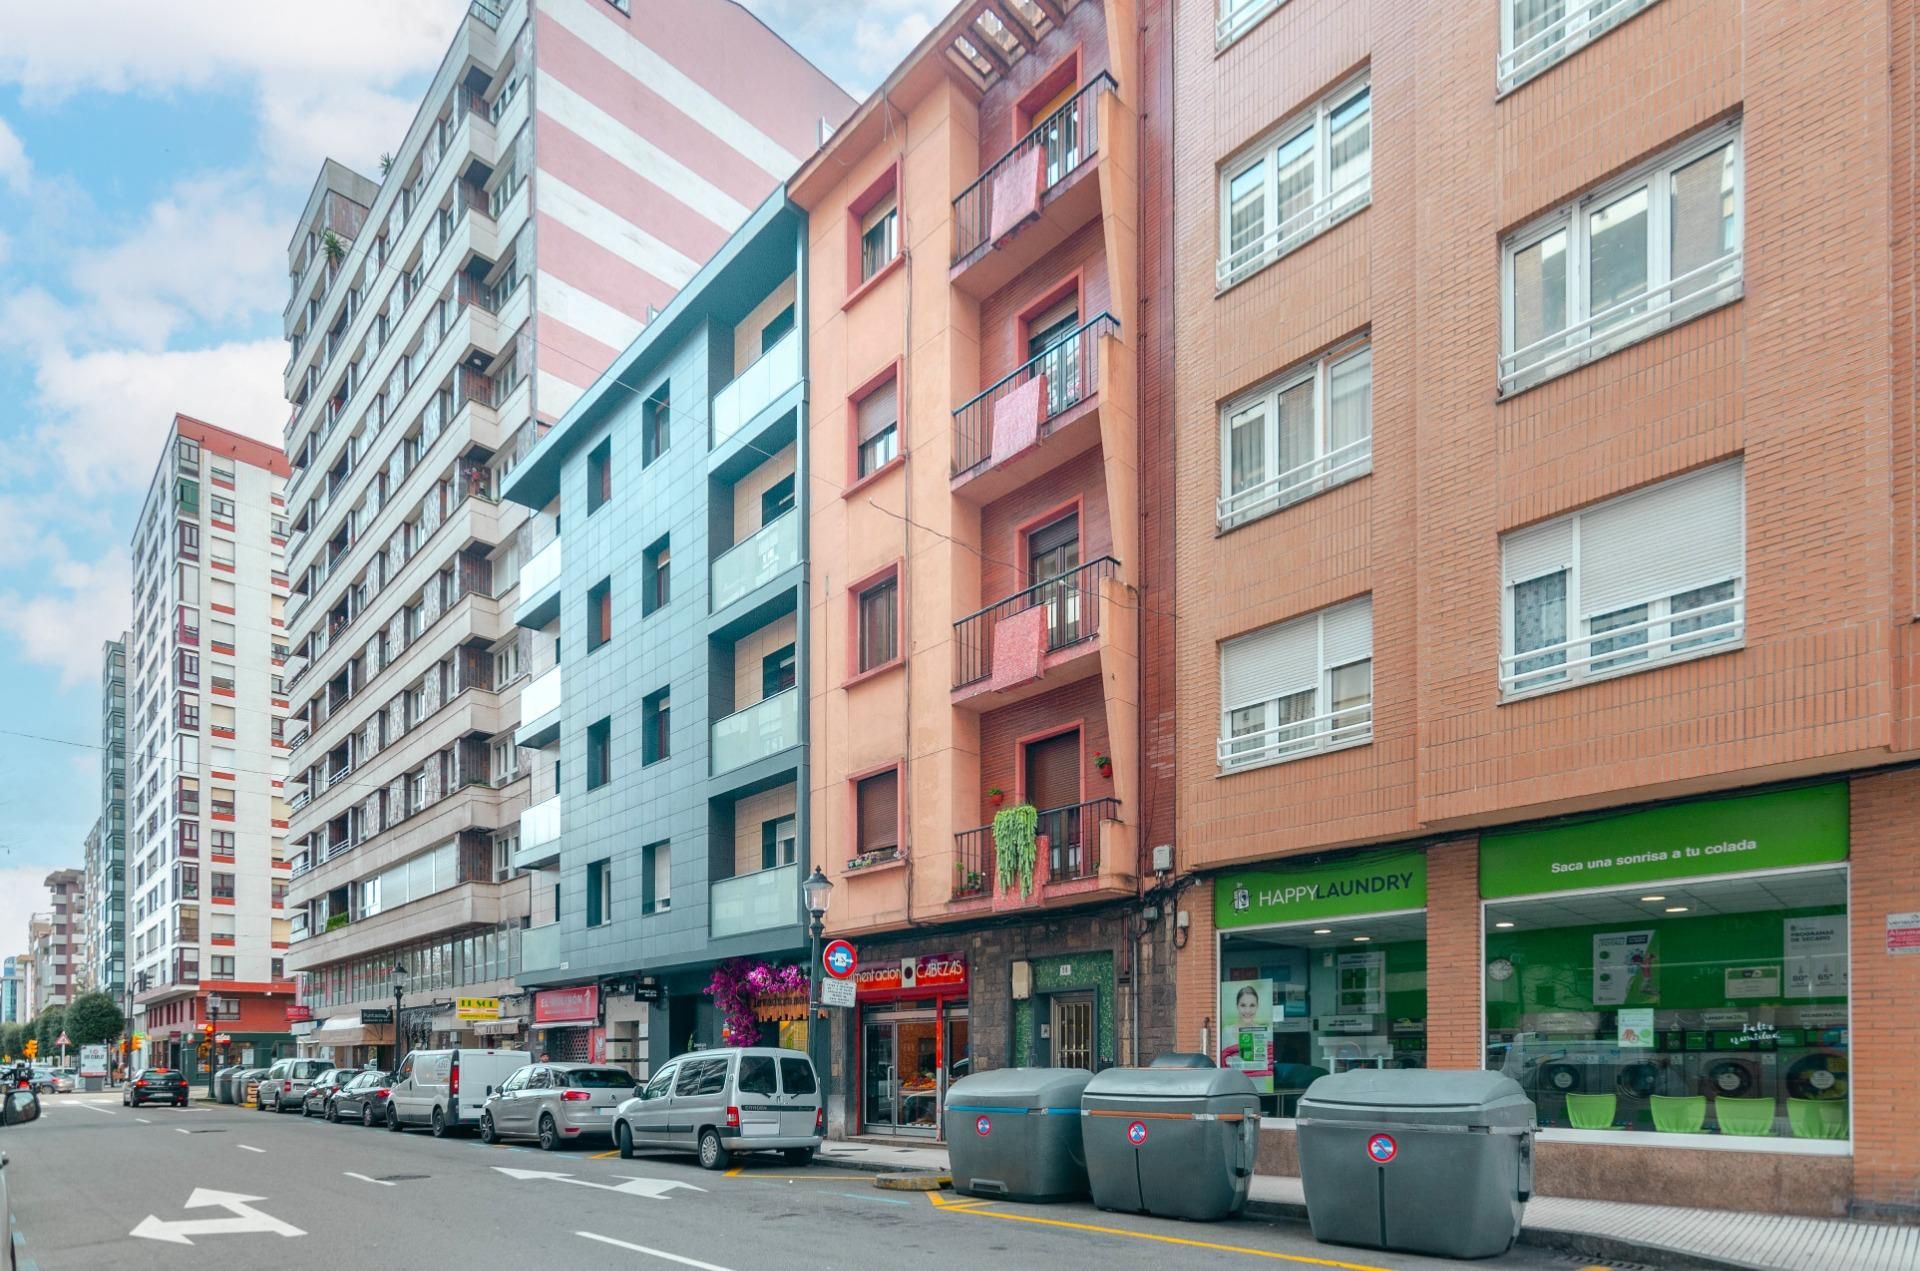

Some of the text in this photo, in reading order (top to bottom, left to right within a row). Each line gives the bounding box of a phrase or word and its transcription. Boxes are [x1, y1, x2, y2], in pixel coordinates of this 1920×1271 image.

[1551, 839, 1757, 874] Saca una sonrisa a tu colada
[1259, 872, 1413, 907] HAPPY LAUNDRY
[916, 959, 962, 979] CABEZAS
